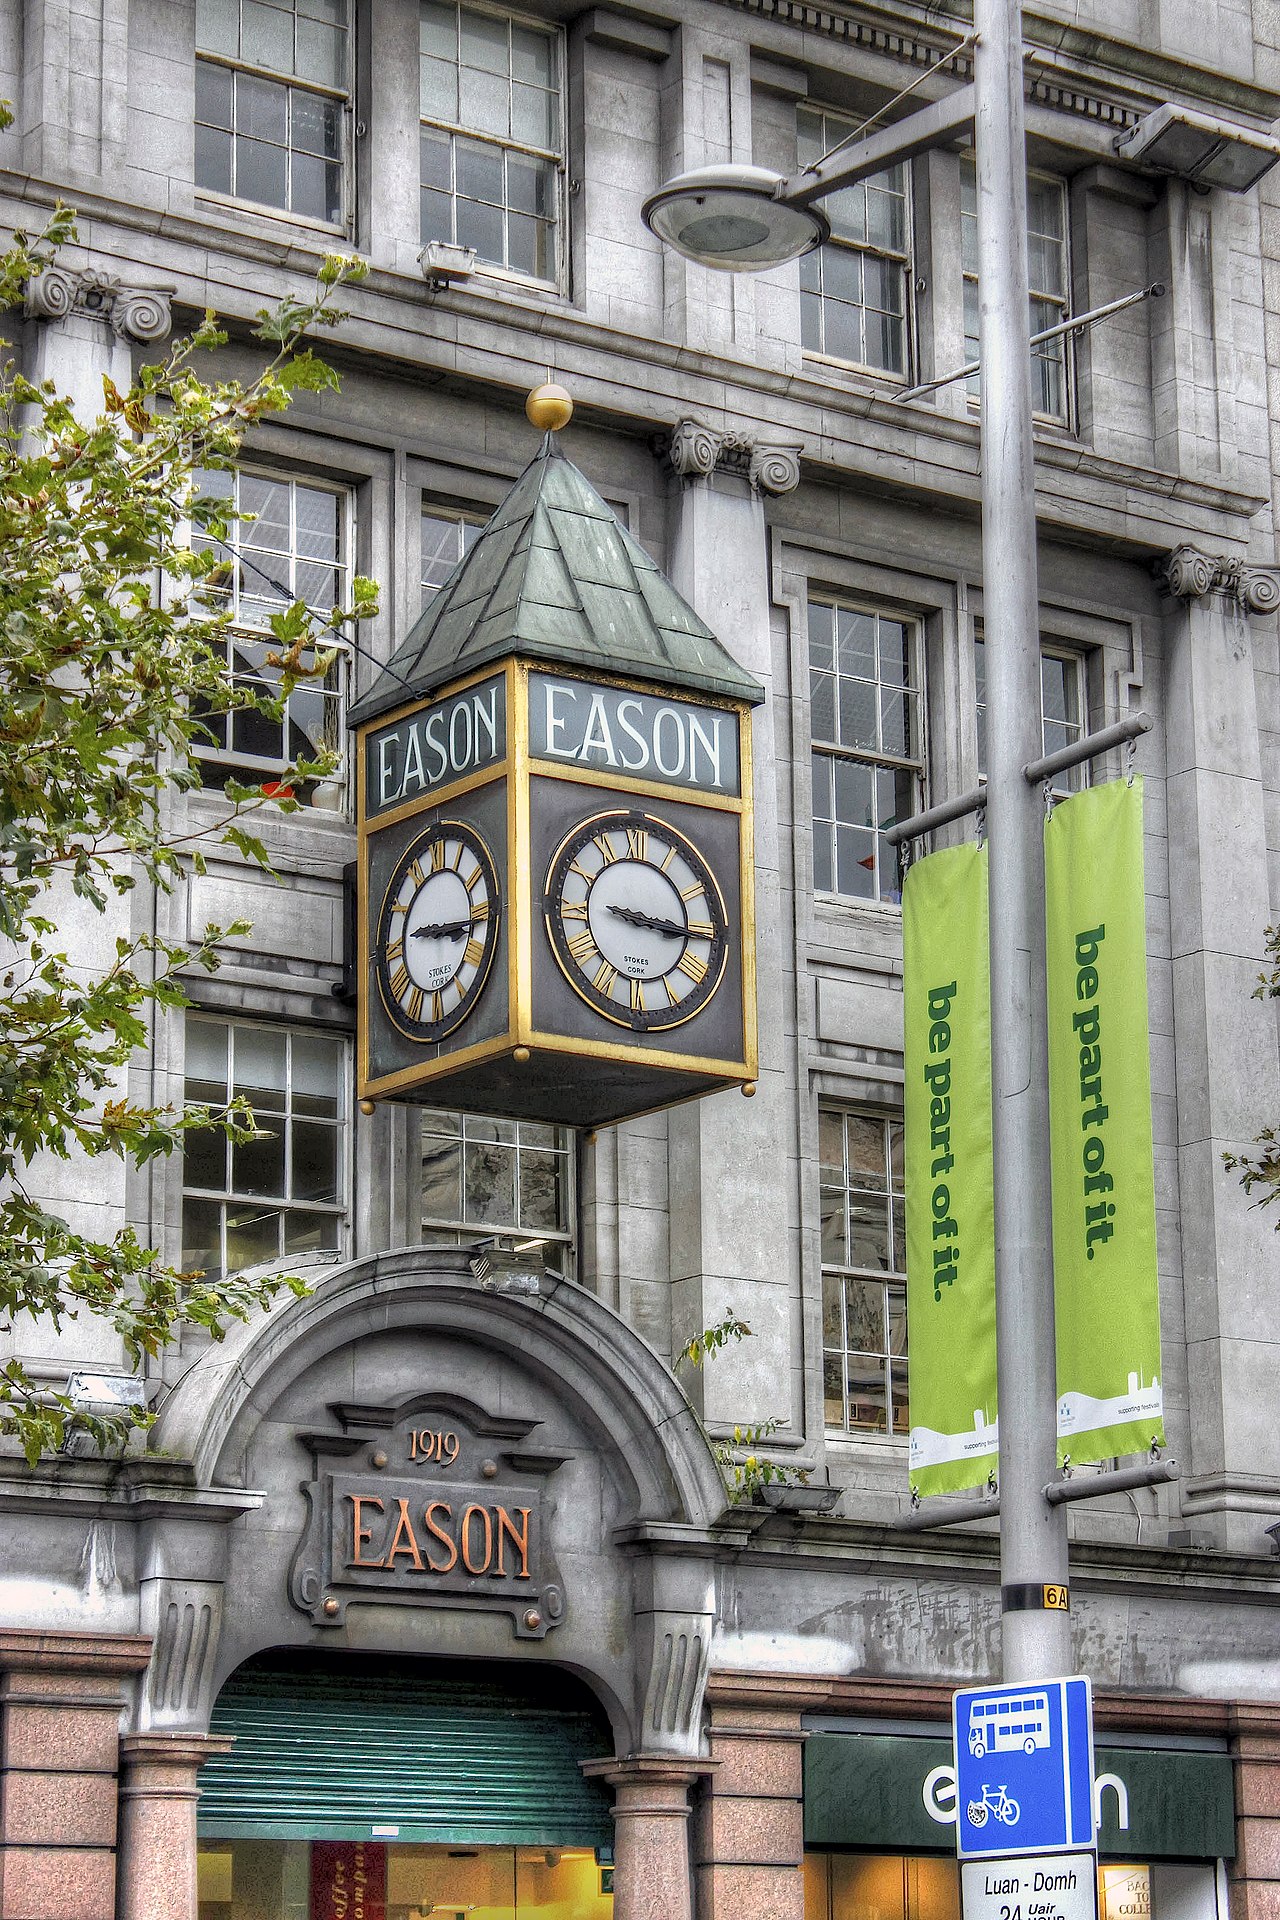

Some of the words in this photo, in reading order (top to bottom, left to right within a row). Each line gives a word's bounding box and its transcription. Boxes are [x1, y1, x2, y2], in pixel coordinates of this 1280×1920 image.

[378, 686, 498, 808] EASON
[543, 683, 723, 788] EASON
[428, 964, 451, 978] STOKES
[624, 955, 649, 966] STOKES
[627, 966, 645, 975] CORK
[1074, 923, 1106, 1001] be
[927, 980, 957, 1054] be
[1072, 1004, 1109, 1131] part
[924, 1058, 957, 1179] part
[1082, 1135, 1114, 1197] of
[931, 1182, 960, 1241] of
[1085, 1202, 1117, 1262] it.
[933, 1248, 960, 1303] it.
[407, 1429, 461, 1467] 1919
[346, 1494, 532, 1578] EASON
[1046, 1587, 1067, 1608] 6A
[332, 1861, 348, 1919] offee
[984, 1875, 1019, 1896] Luan
[1033, 1870, 1077, 1892] Domh
[1028, 1902, 1056, 1915] Uair
[1119, 1903, 1151, 1915] COLLE
[1127, 1880, 1150, 1892] BAC
[1135, 1892, 1149, 1903] TO
